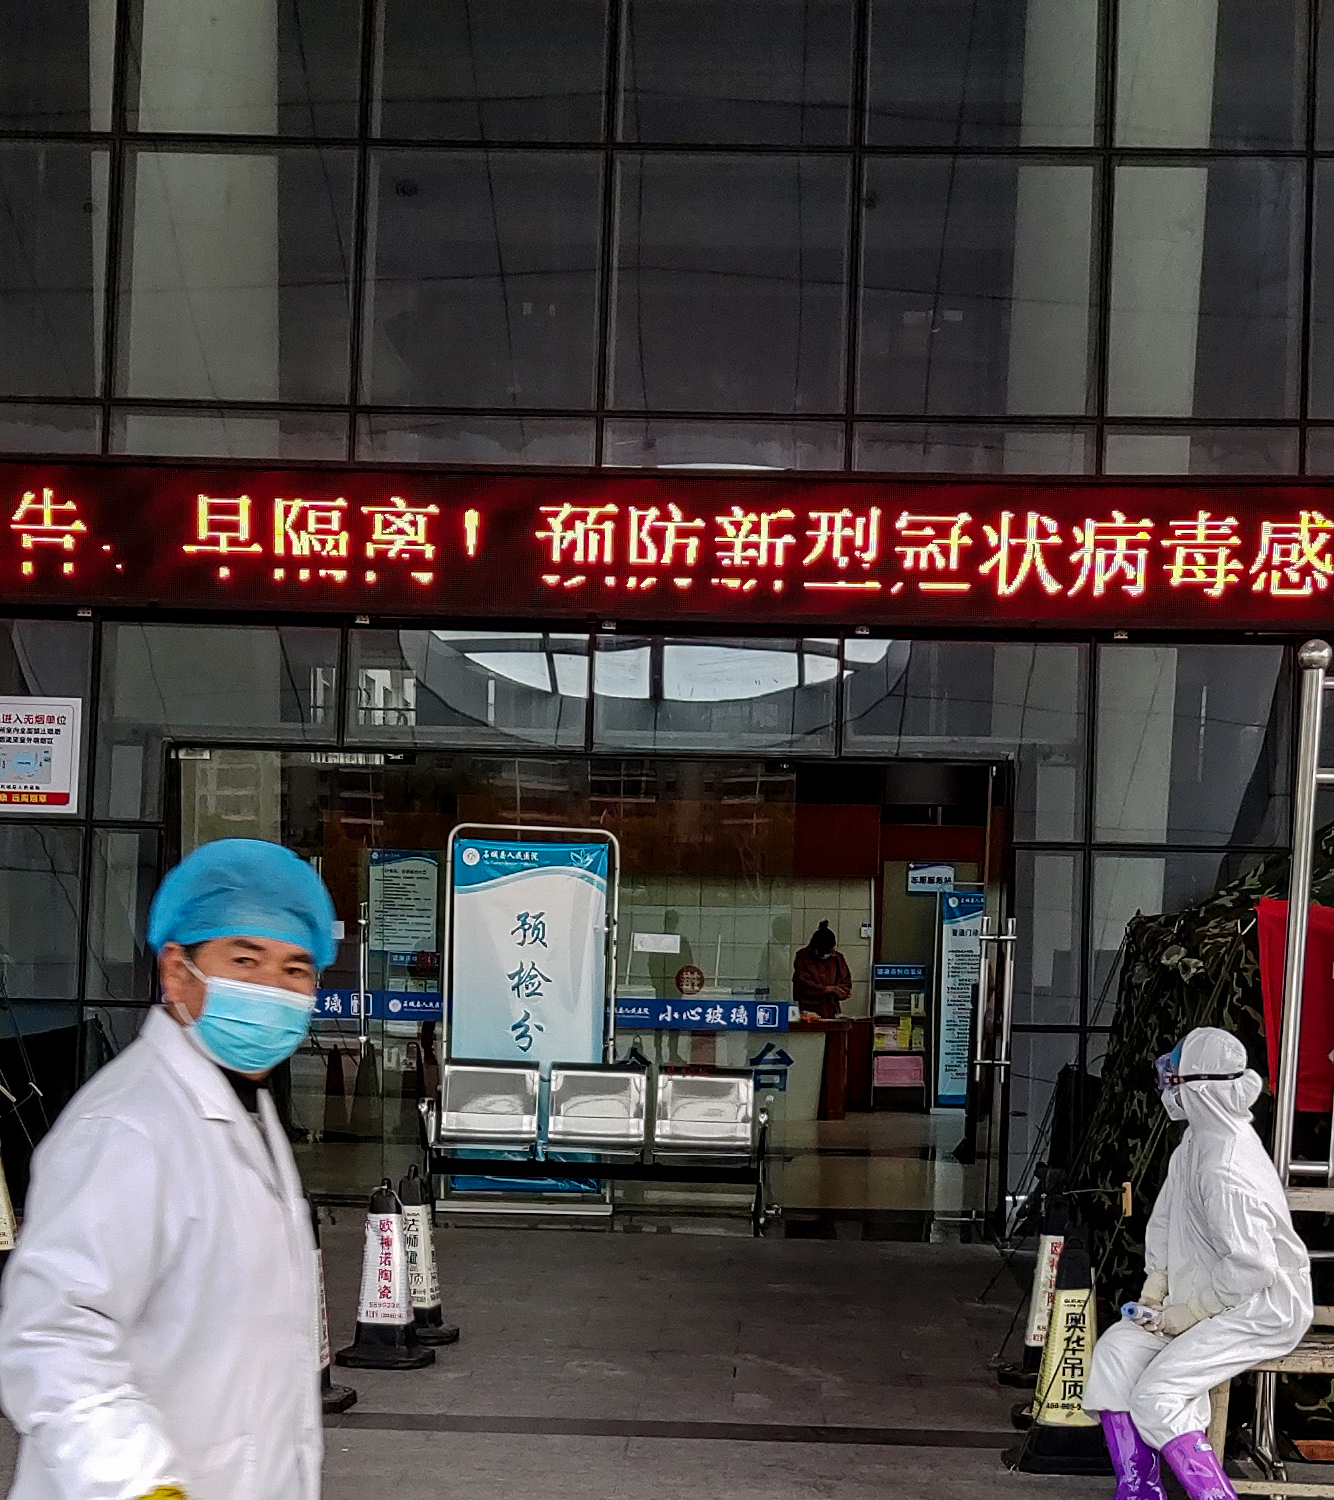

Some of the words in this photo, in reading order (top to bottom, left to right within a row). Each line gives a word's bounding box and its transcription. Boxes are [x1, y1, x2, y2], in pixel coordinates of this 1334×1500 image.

[506, 911, 553, 1053] 预检分
[658, 1004, 749, 1026] 小心玻璃
[378, 1219, 393, 1300] 欧神诺陶瓷
